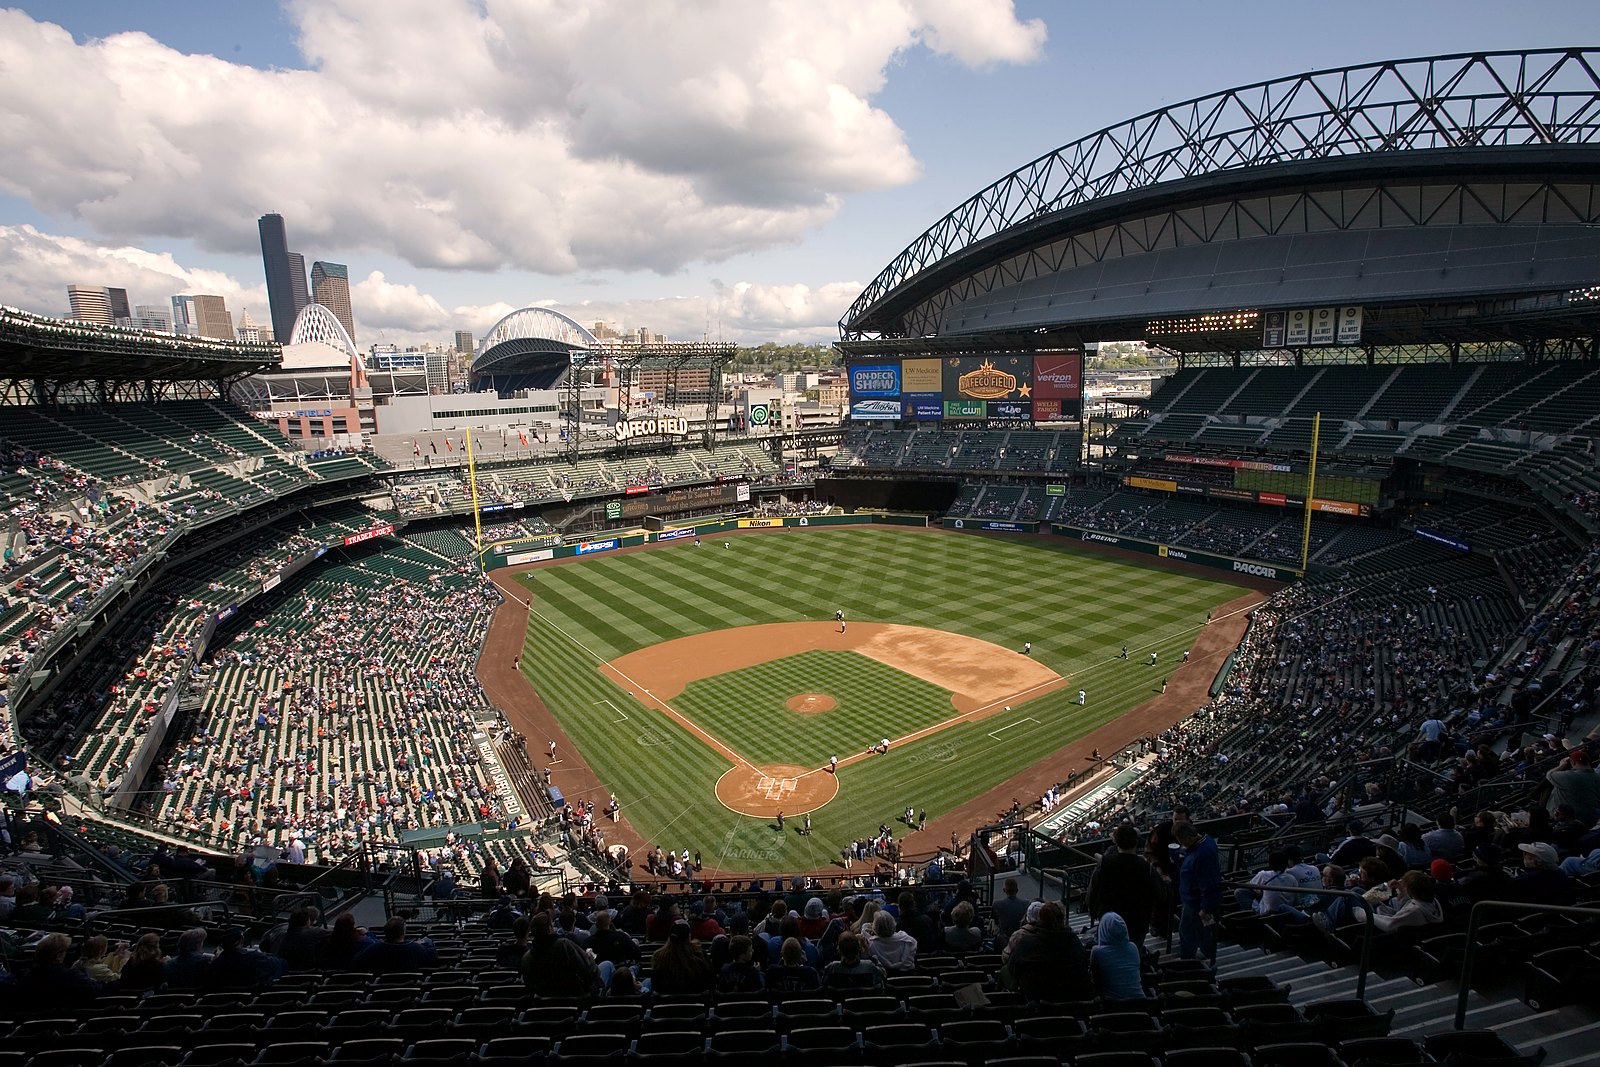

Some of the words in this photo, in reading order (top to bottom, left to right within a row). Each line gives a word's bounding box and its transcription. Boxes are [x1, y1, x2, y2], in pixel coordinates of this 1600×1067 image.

[856, 372, 894, 380] ON-DECK
[960, 377, 990, 389] SAFECO
[991, 376, 1014, 389] FIELD
[1038, 373, 1072, 382] verizon
[856, 380, 894, 390] SHOW
[256, 410, 296, 419] QWEST
[296, 409, 332, 417] FIELD
[615, 419, 657, 441] SAFECO
[657, 416, 688, 435] FIELD
[1200, 457, 1229, 466] Budweiser
[665, 493, 687, 502] Welcome
[694, 490, 709, 499] Safeco
[710, 488, 722, 496] Field
[653, 504, 672, 512] Home
[672, 502, 680, 510] of
[680, 500, 689, 508] the
[689, 497, 709, 507] Seattle
[1320, 504, 1353, 514] Microsoft
[348, 531, 374, 545] TRADER
[374, 525, 391, 537] JOE'S
[1090, 533, 1118, 544] BOEING
[587, 541, 614, 551] PEPSI
[1168, 549, 1187, 559] WaMu
[1233, 561, 1276, 579] PACCAR
[477, 740, 498, 765] WELCOME
[488, 764, 502, 775] TO
[492, 773, 512, 796] SAFECO
[503, 795, 520, 815] FIELD
[1043, 803, 1082, 831] SEATTLE
[1078, 785, 1118, 813] MARINERS
[717, 846, 781, 861] MARINERS
